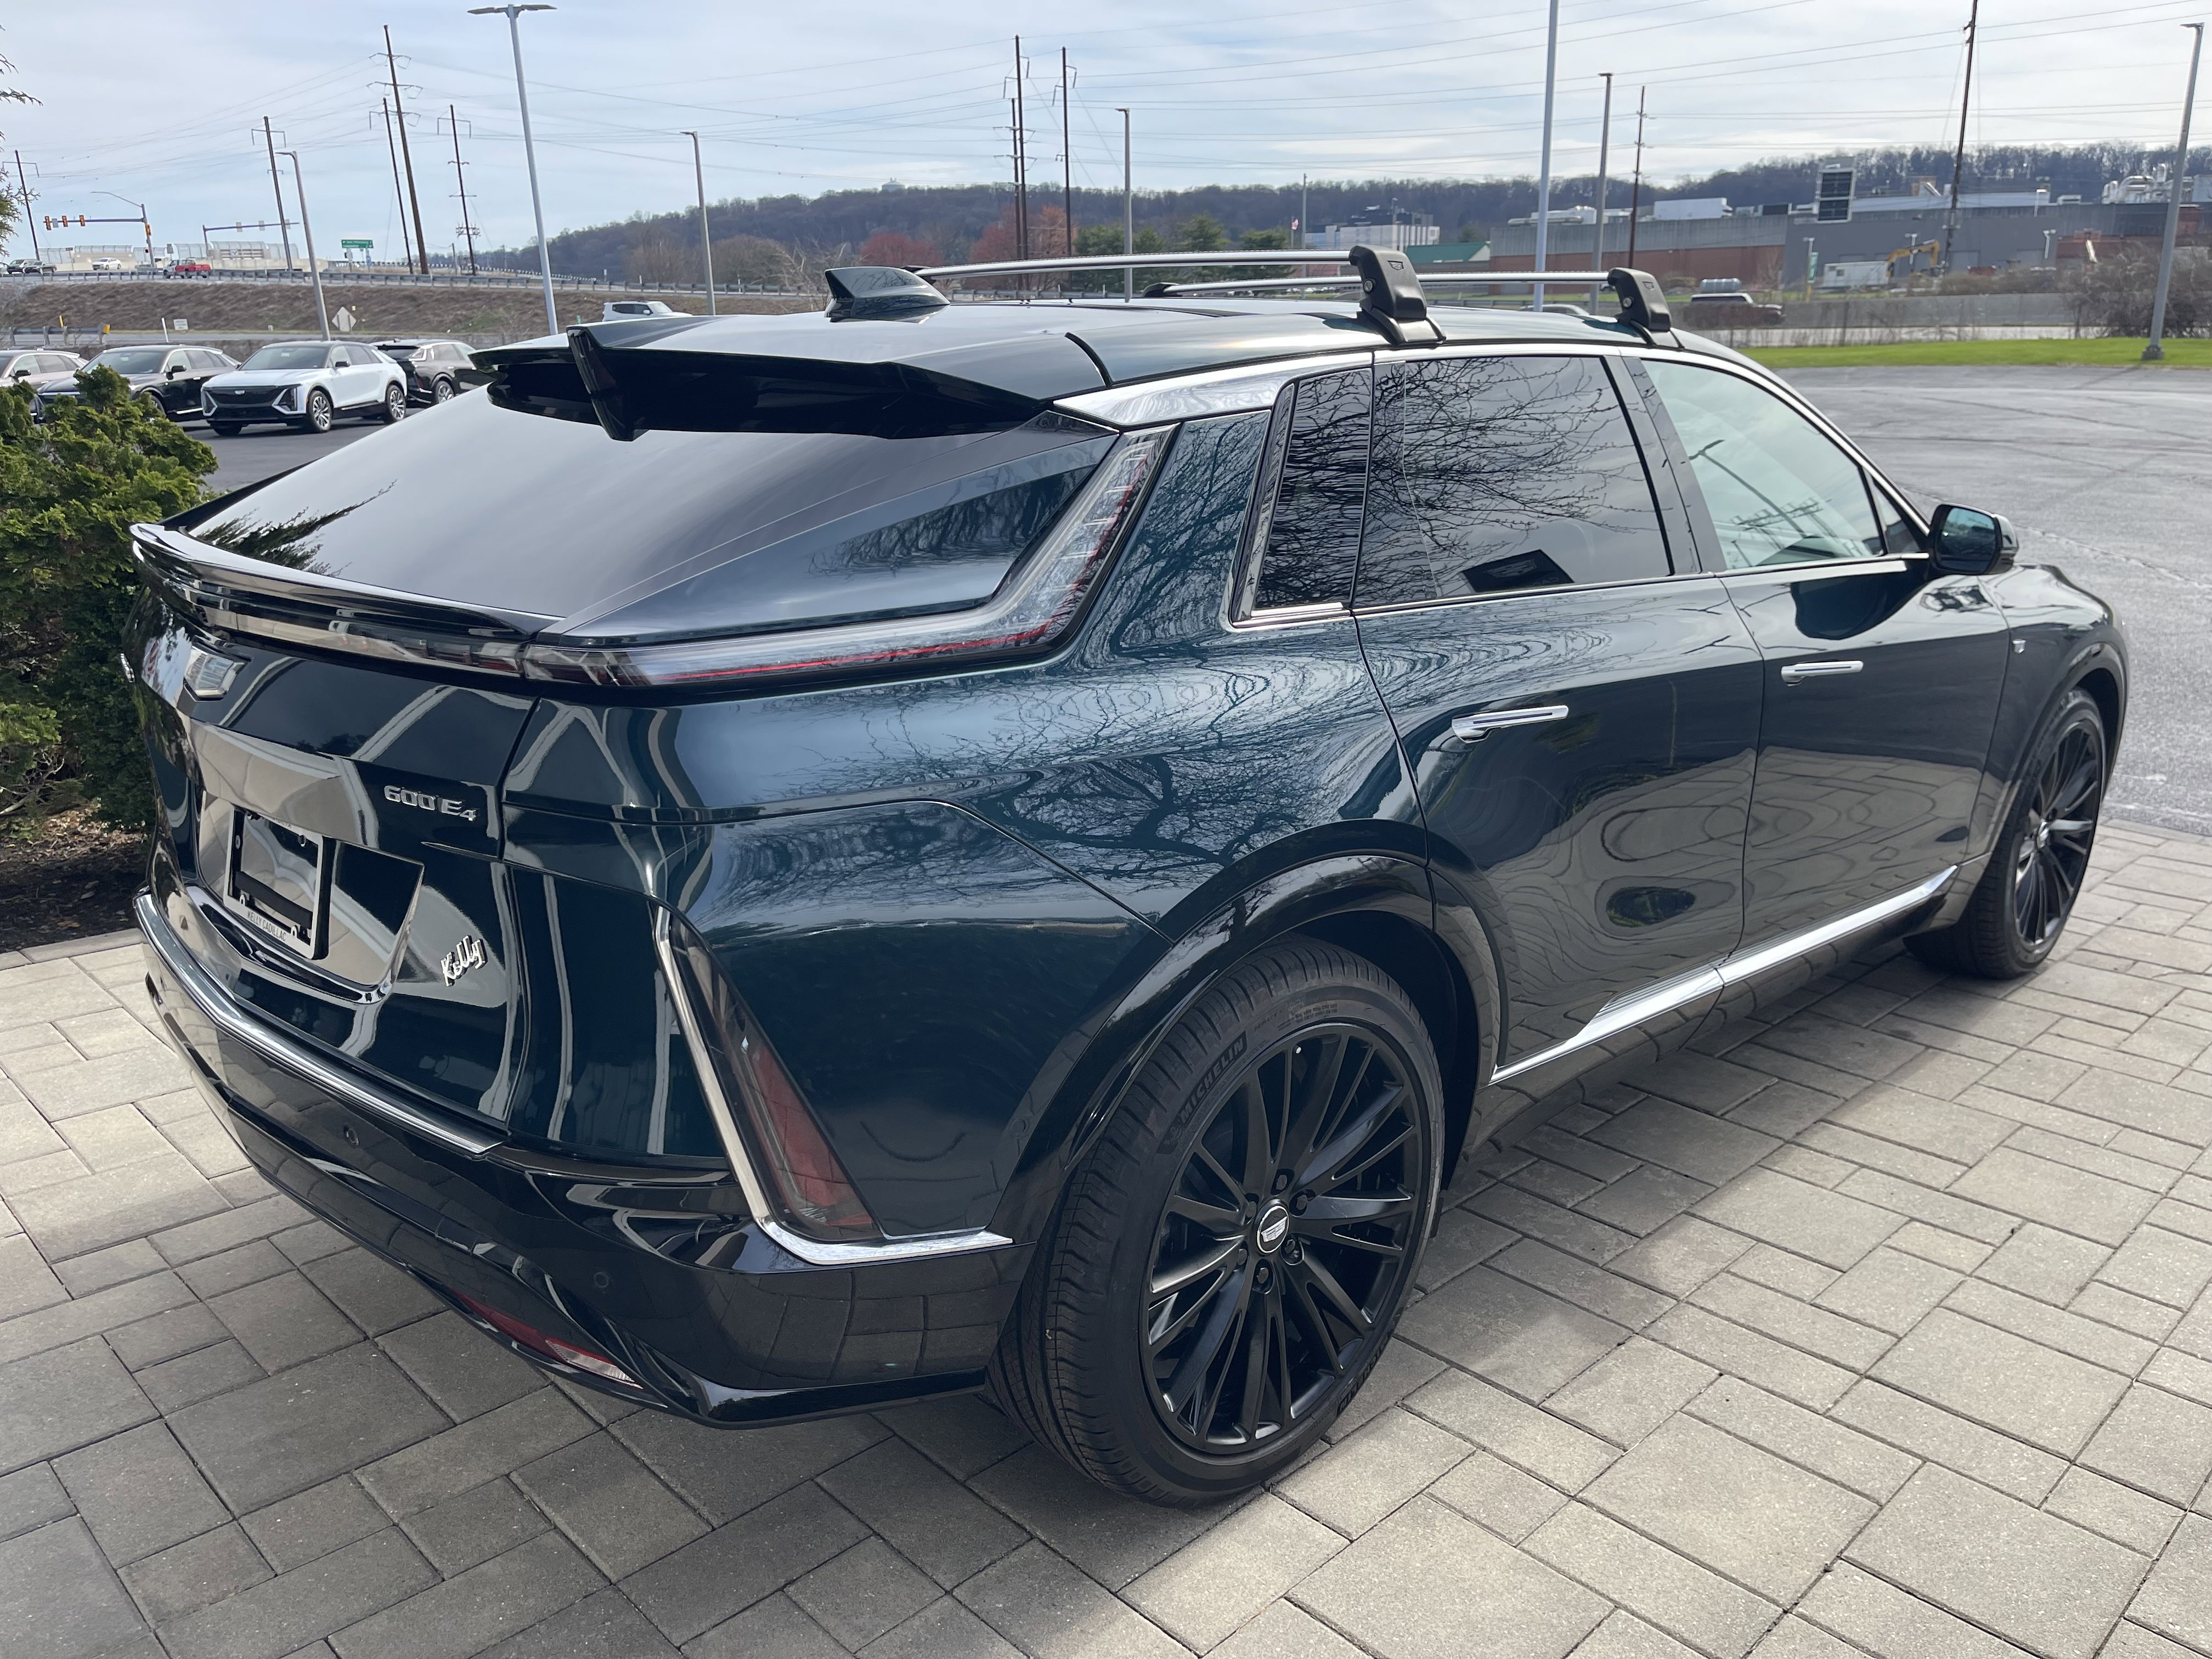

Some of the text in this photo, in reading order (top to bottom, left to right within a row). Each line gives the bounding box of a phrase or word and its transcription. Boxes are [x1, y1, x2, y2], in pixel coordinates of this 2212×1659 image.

[247, 911, 286, 941] KELLY CADILLAC
[441, 935, 486, 986] Kelly
[1180, 1037, 1244, 1124] MICHELIN
